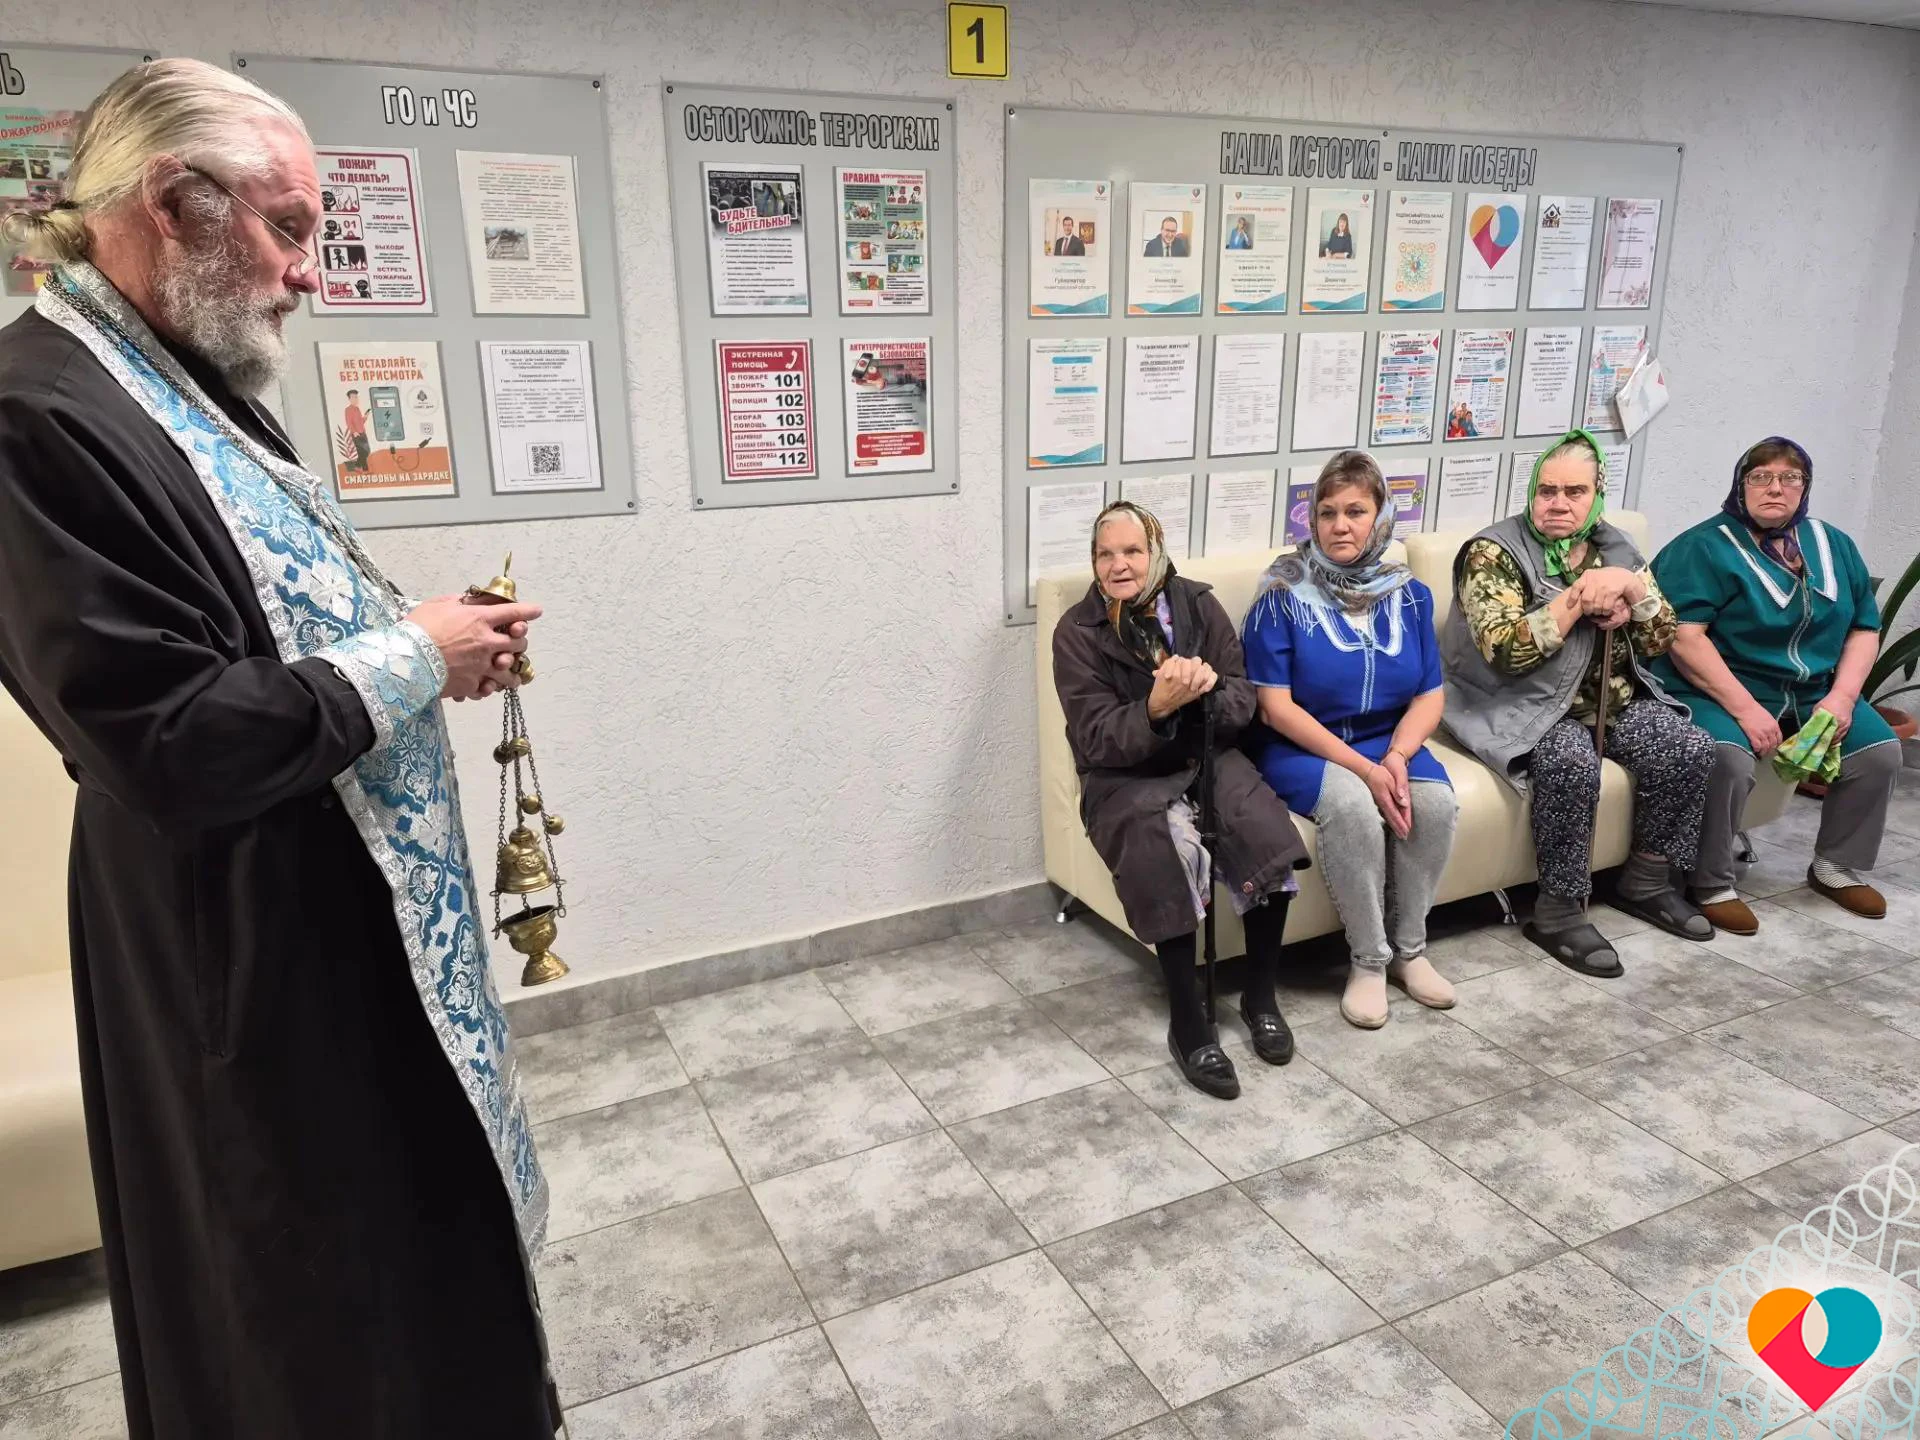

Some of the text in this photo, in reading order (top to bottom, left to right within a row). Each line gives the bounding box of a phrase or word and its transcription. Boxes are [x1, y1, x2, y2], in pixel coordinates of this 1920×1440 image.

[966, 17, 985, 64] 1
[381, 86, 478, 128] ГО и ЧС
[684, 104, 940, 151] ОСТОРОЖНО: ТЕРРОРИЗМ!
[338, 158, 376, 170] ПОЖАР!
[1220, 132, 1283, 176] НАША
[1288, 136, 1380, 180] ИСТОРИЯ
[1396, 142, 1455, 182] НАШИ
[1458, 145, 1538, 191] ПОБЕДЫ
[328, 172, 390, 184] ЧТО ДЕЛАТЬ?!
[843, 172, 880, 183] ПРАВИЛА
[720, 207, 756, 221] БУДЬТЕ
[343, 220, 357, 229] 01
[728, 215, 791, 233] БДИТЕЛЬНЫ!
[731, 351, 783, 359] ЭКСТРЕННАЯ
[880, 350, 926, 358] БЕЗОПАСНОСТЬ
[343, 356, 417, 369] НЕ ОСТАВЛЯЙТЕ
[340, 369, 424, 382] БЕЗ ПРИСМОТРА
[774, 374, 801, 387] 101
[776, 394, 803, 407] 102
[777, 413, 804, 427] 103
[778, 433, 806, 446] 104
[779, 452, 806, 465] 112
[344, 471, 450, 485] СМАРТФОНЫ НА ЗАРЯДКЕ
